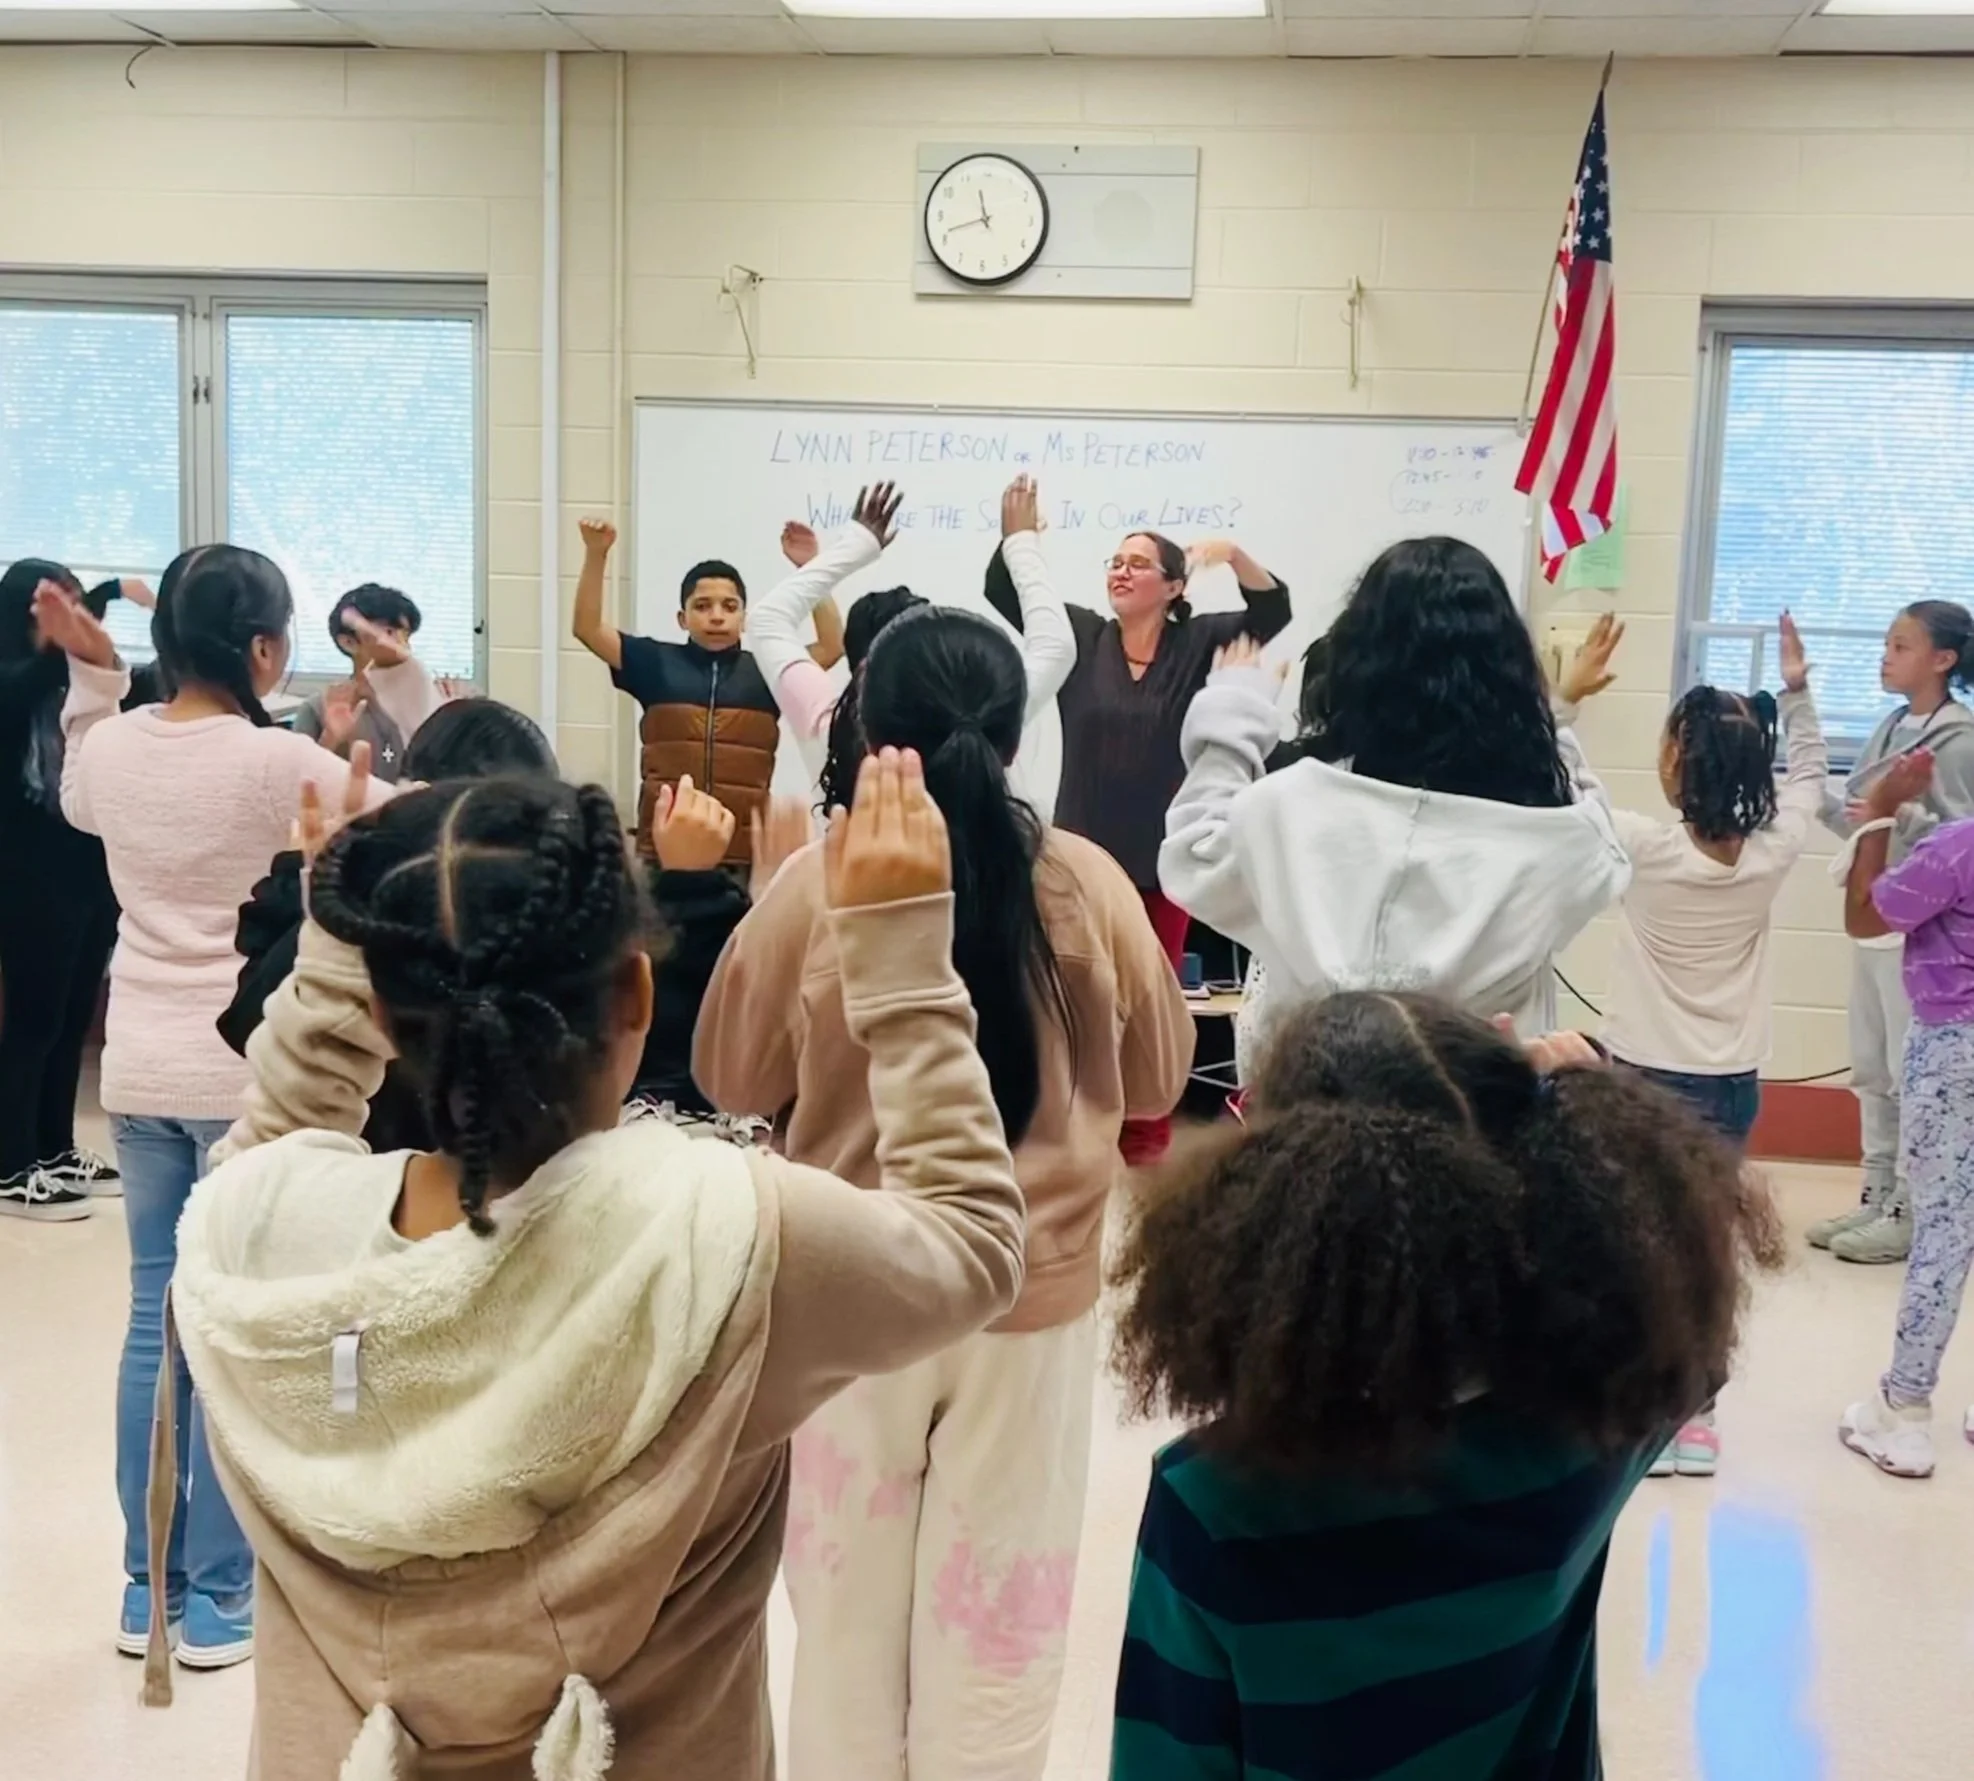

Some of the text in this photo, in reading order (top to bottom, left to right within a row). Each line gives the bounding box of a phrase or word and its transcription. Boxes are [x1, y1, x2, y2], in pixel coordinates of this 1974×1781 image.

[770, 429, 852, 464] LYNN
[866, 430, 1009, 464] PETERSON
[1082, 431, 1206, 468] PETERSON
[924, 504, 966, 530] THE
